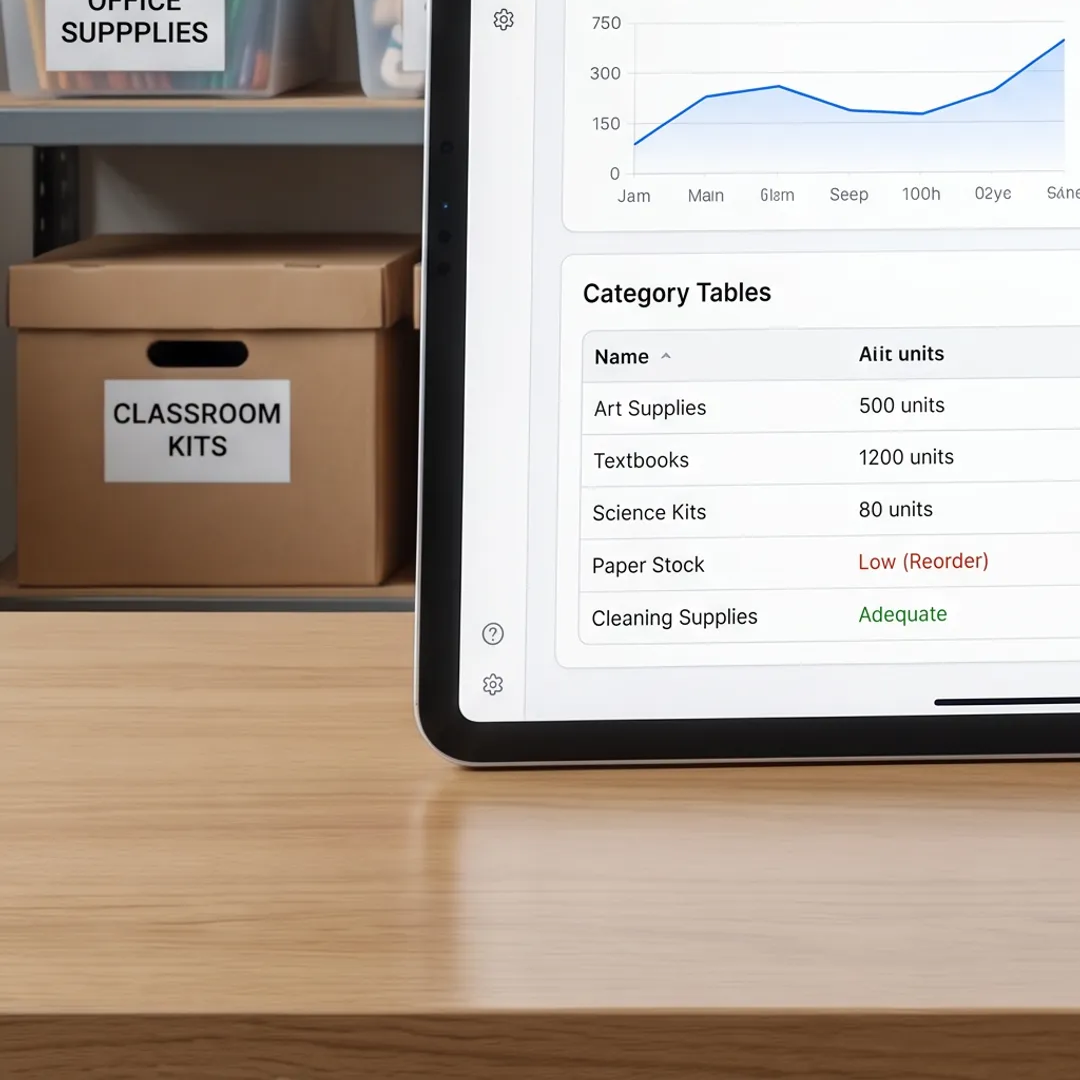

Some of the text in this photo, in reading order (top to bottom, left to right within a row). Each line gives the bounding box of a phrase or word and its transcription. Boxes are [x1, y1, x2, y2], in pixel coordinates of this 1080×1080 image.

[592, 15, 622, 30] 750
[61, 21, 208, 44] SUPPPLIES
[590, 66, 621, 81] 300
[592, 116, 621, 131] 150
[610, 166, 621, 181] 0
[617, 188, 651, 203] Jam
[829, 187, 869, 205] Seep
[902, 186, 941, 201] 100h
[583, 281, 772, 309] Category Tables
[595, 348, 649, 365] Name
[898, 344, 945, 362] units
[113, 402, 281, 425] CLASSROOM
[593, 398, 707, 421] Art Supplies
[859, 396, 945, 414] 500 units
[168, 435, 228, 457] KITS
[593, 451, 689, 469] Textbooks
[859, 447, 955, 466] 1200 units
[592, 503, 707, 522] Science Kits
[859, 500, 933, 518] 80 units
[592, 555, 705, 578] Paper Stock
[859, 551, 989, 573] Low (Reorder)
[591, 607, 758, 630] Cleaning Supplies
[858, 606, 948, 627] Adequate
